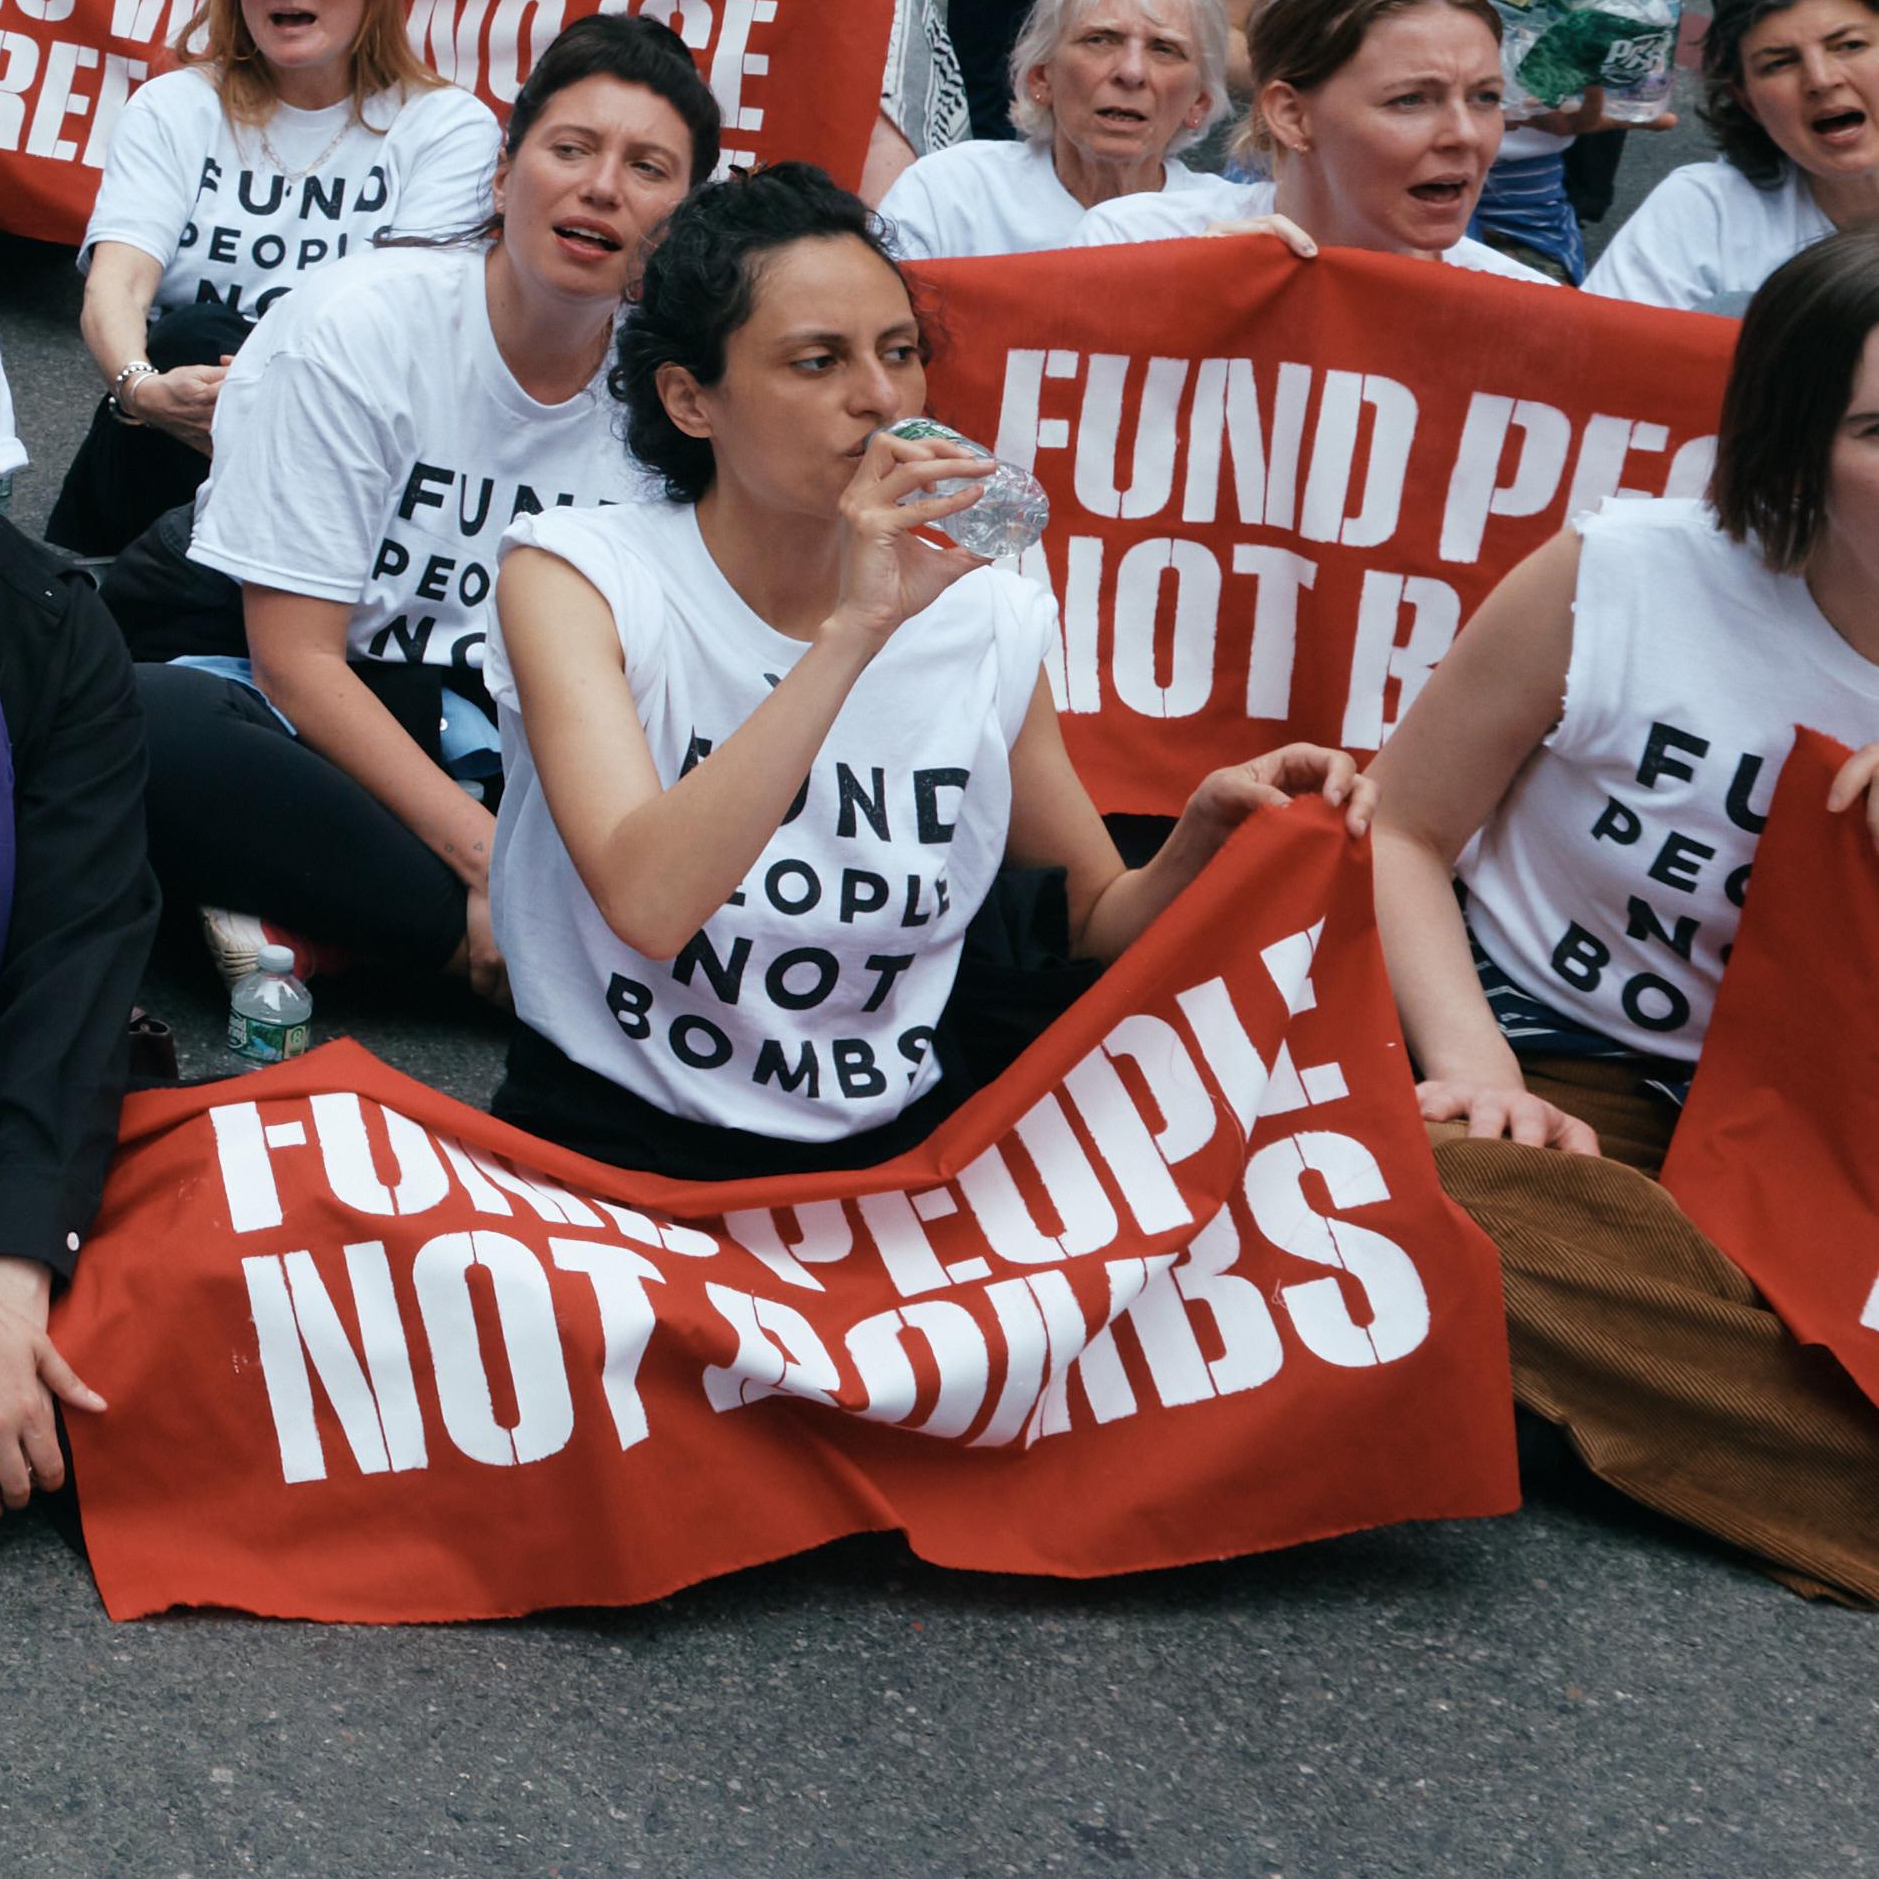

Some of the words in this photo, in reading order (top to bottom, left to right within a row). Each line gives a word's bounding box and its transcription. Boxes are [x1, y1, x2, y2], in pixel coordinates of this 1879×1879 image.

[996, 347, 1421, 549] FUND
[605, 969, 937, 1102] BOMBS
[669, 927, 915, 1015] NOT
[241, 1227, 669, 1486] NOT
